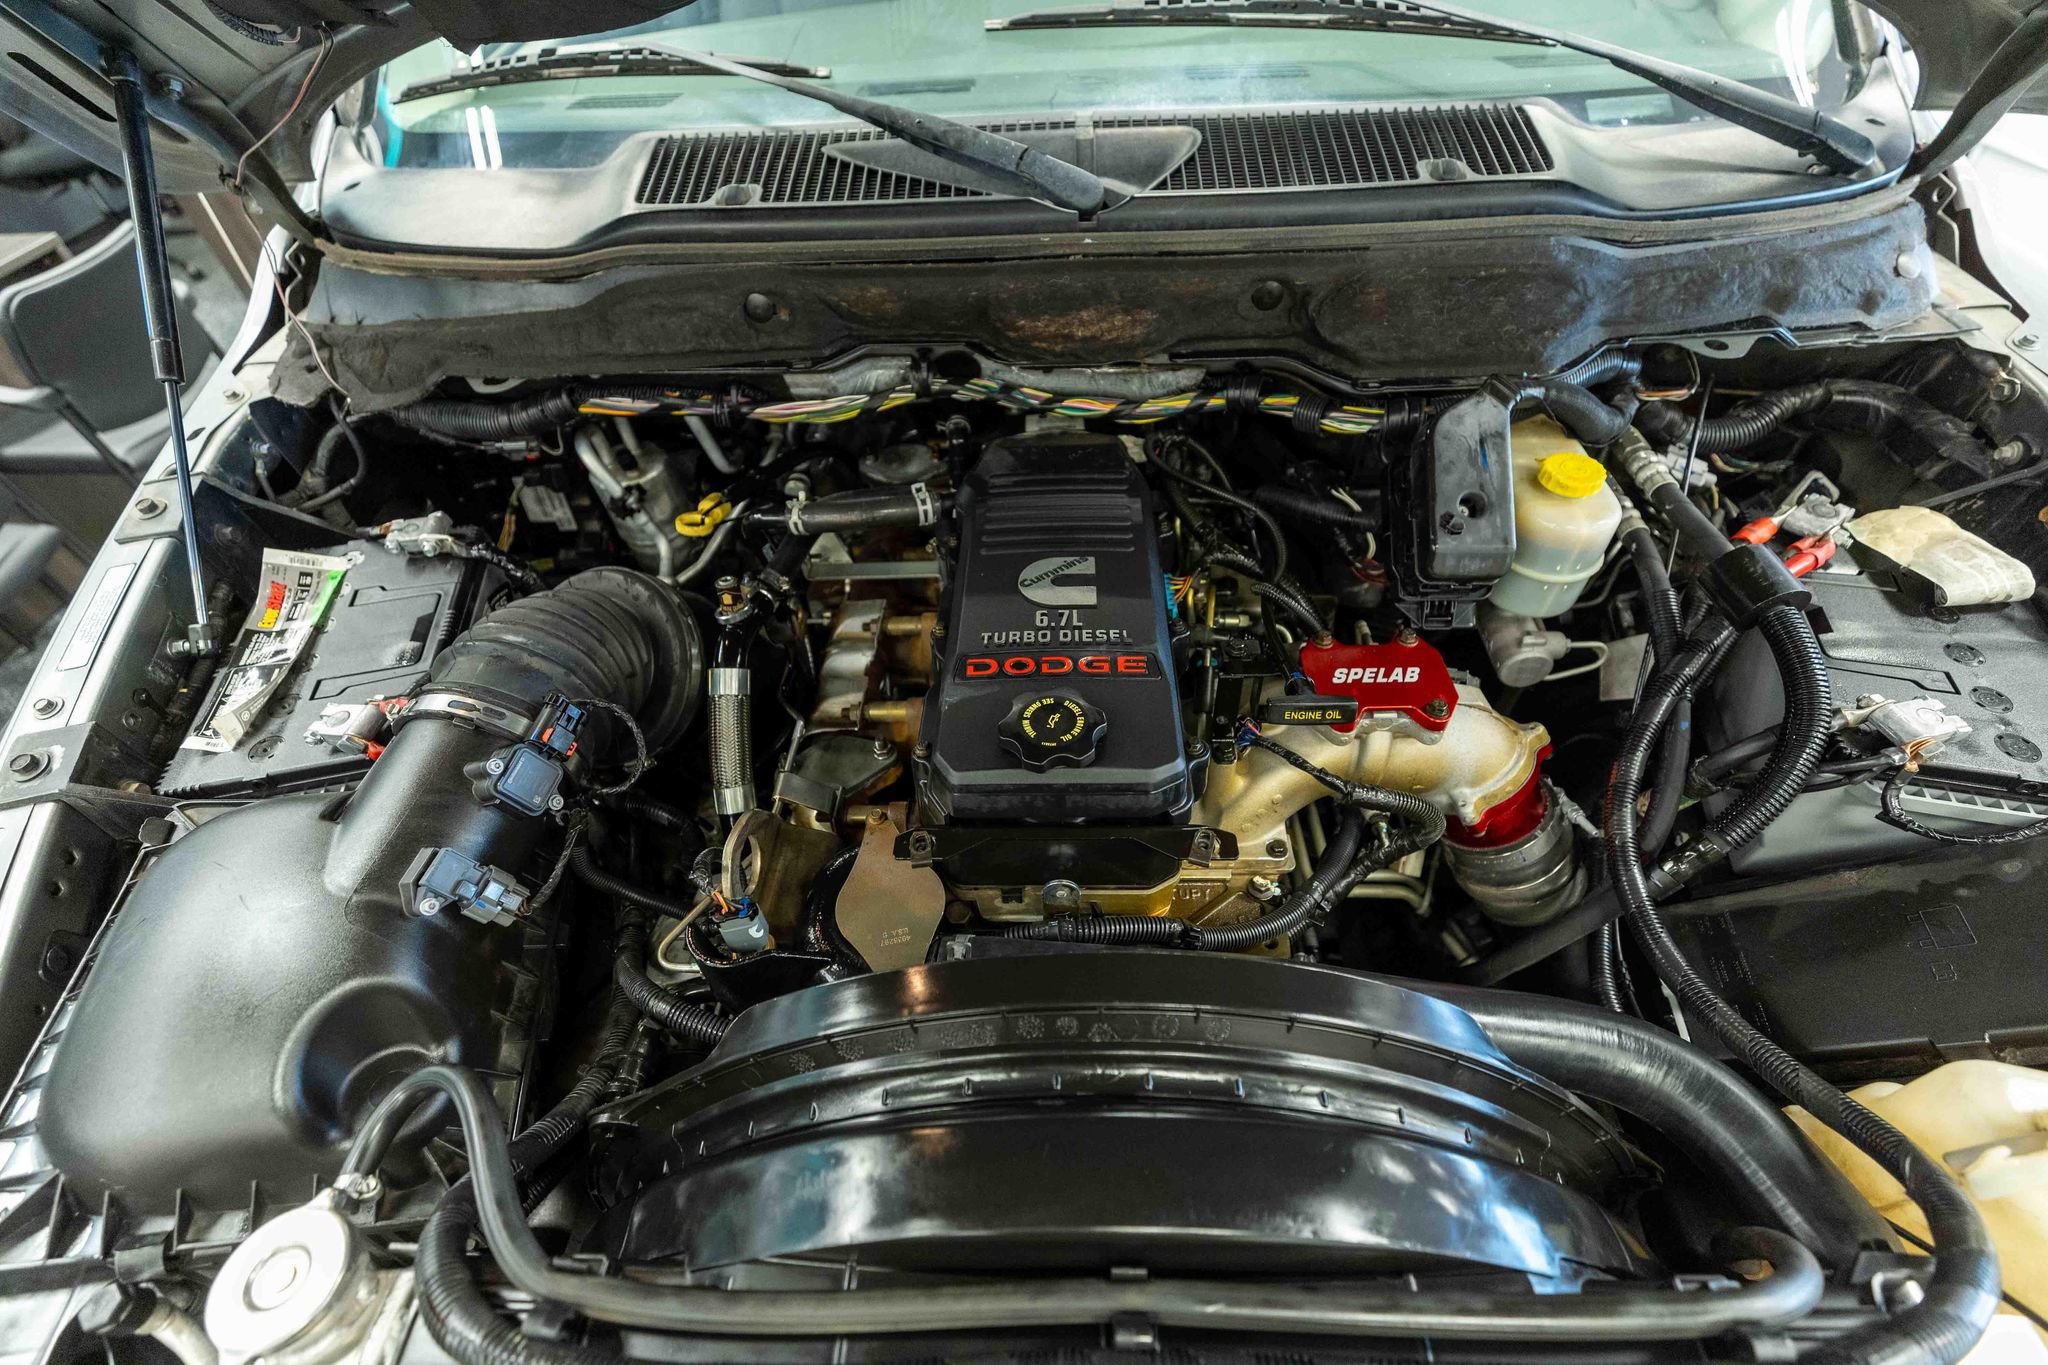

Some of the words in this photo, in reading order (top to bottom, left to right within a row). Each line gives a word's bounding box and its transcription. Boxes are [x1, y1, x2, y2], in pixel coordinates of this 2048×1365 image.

[1019, 556, 1089, 588] Cummins
[1035, 610, 1083, 627] 6.7L
[981, 630, 1051, 645] TURBO
[1059, 629, 1133, 645] DIESEL
[966, 655, 1149, 678] DODGE
[1332, 667, 1421, 684] SPELAB
[1063, 700, 1082, 716] DIESEL
[1284, 710, 1323, 721] ENGINE
[1325, 710, 1342, 720] OIL
[1071, 717, 1084, 736] ENGINE
[1060, 734, 1072, 742] OIL
